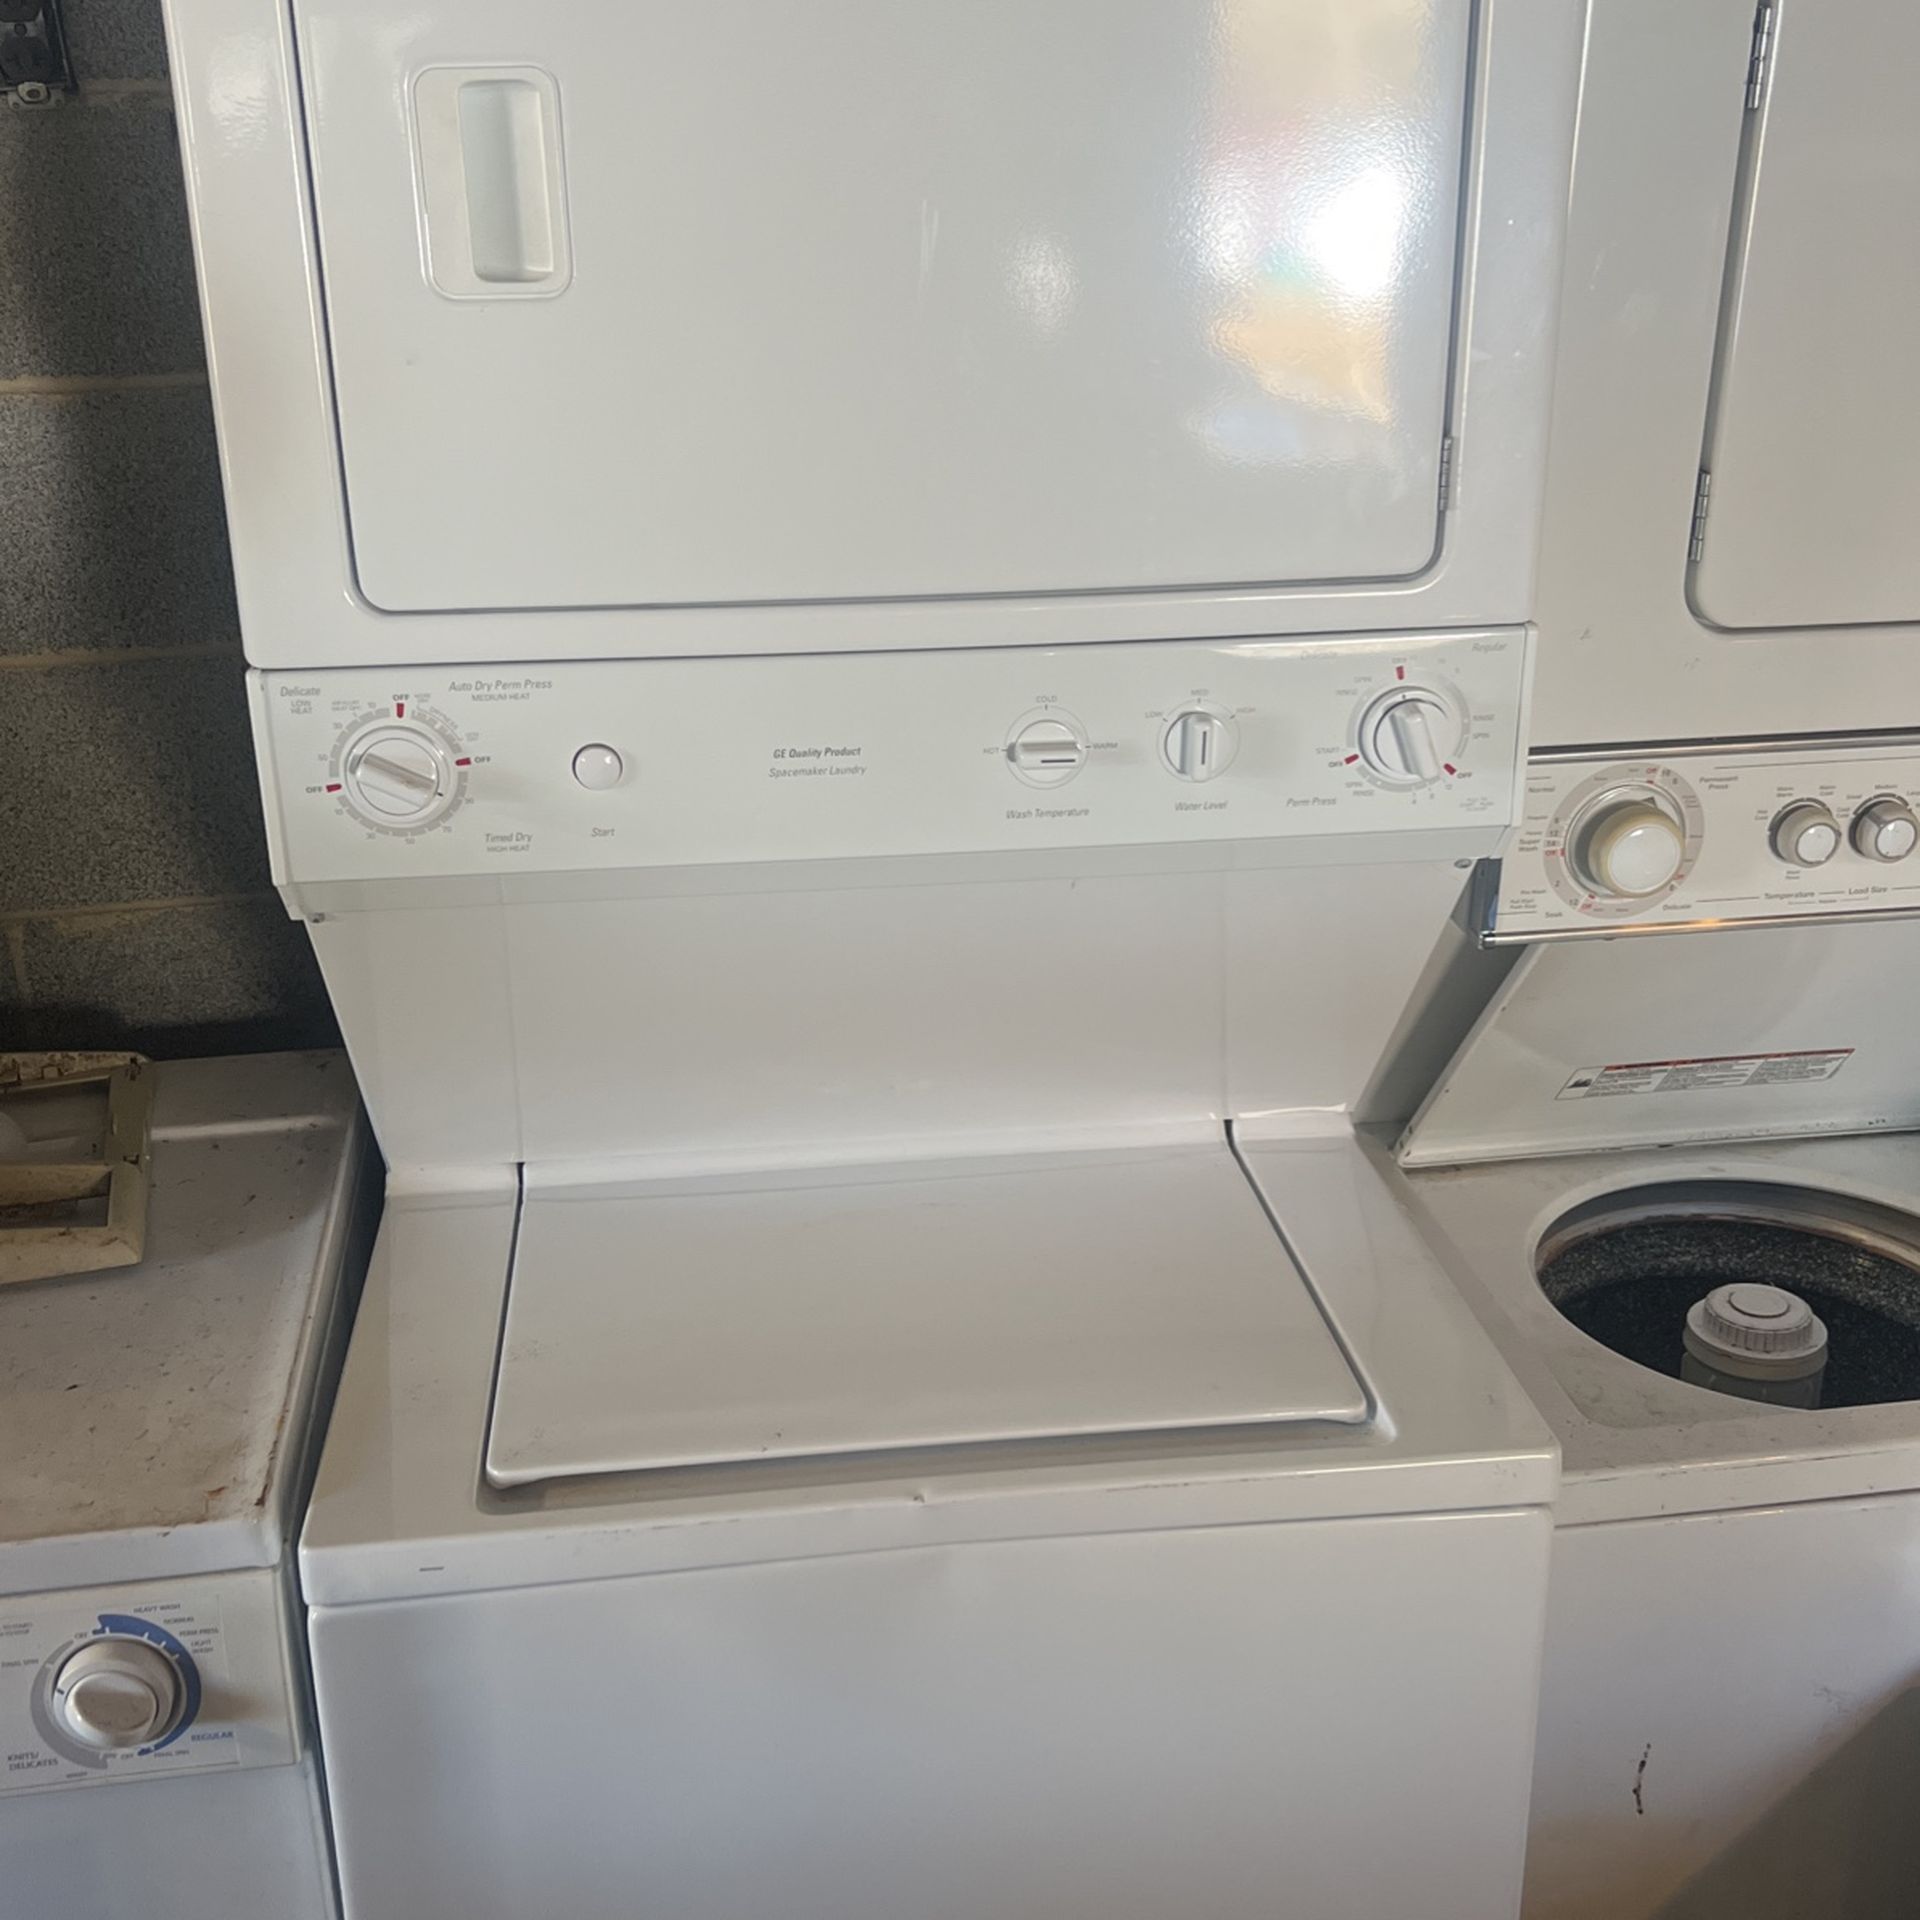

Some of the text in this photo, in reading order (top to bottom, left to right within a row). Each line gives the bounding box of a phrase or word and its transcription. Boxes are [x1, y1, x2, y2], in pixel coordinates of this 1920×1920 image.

[1473, 642, 1508, 654] Regular
[448, 678, 553, 692] Auto Dry Perm Press
[279, 685, 322, 697] Delicate
[508, 692, 531, 701] HEAT
[391, 693, 410, 702] OFF
[1035, 695, 1057, 704] COLD
[290, 707, 313, 715] HEAT
[773, 747, 862, 760] GE Quality Product
[983, 746, 1000, 756] HOT
[474, 756, 492, 764] OFF
[768, 764, 868, 779] Spacemaker Laundry
[1456, 771, 1473, 780] OFF
[305, 785, 323, 794] OFF
[1174, 799, 1228, 812] Water Level
[1286, 796, 1337, 808] Perm Press
[1005, 807, 1091, 820] Wash Temperature
[590, 826, 616, 837] Start
[485, 832, 532, 845] Timed Dry
[1763, 891, 1816, 901] Temperature
[1848, 886, 1888, 896] Load Size
[133, 1603, 181, 1614] HEAVY WASH
[190, 1731, 234, 1742] REGULAR
[7, 1752, 40, 1763] KNITS/
[9, 1757, 60, 1772] DELICATES
